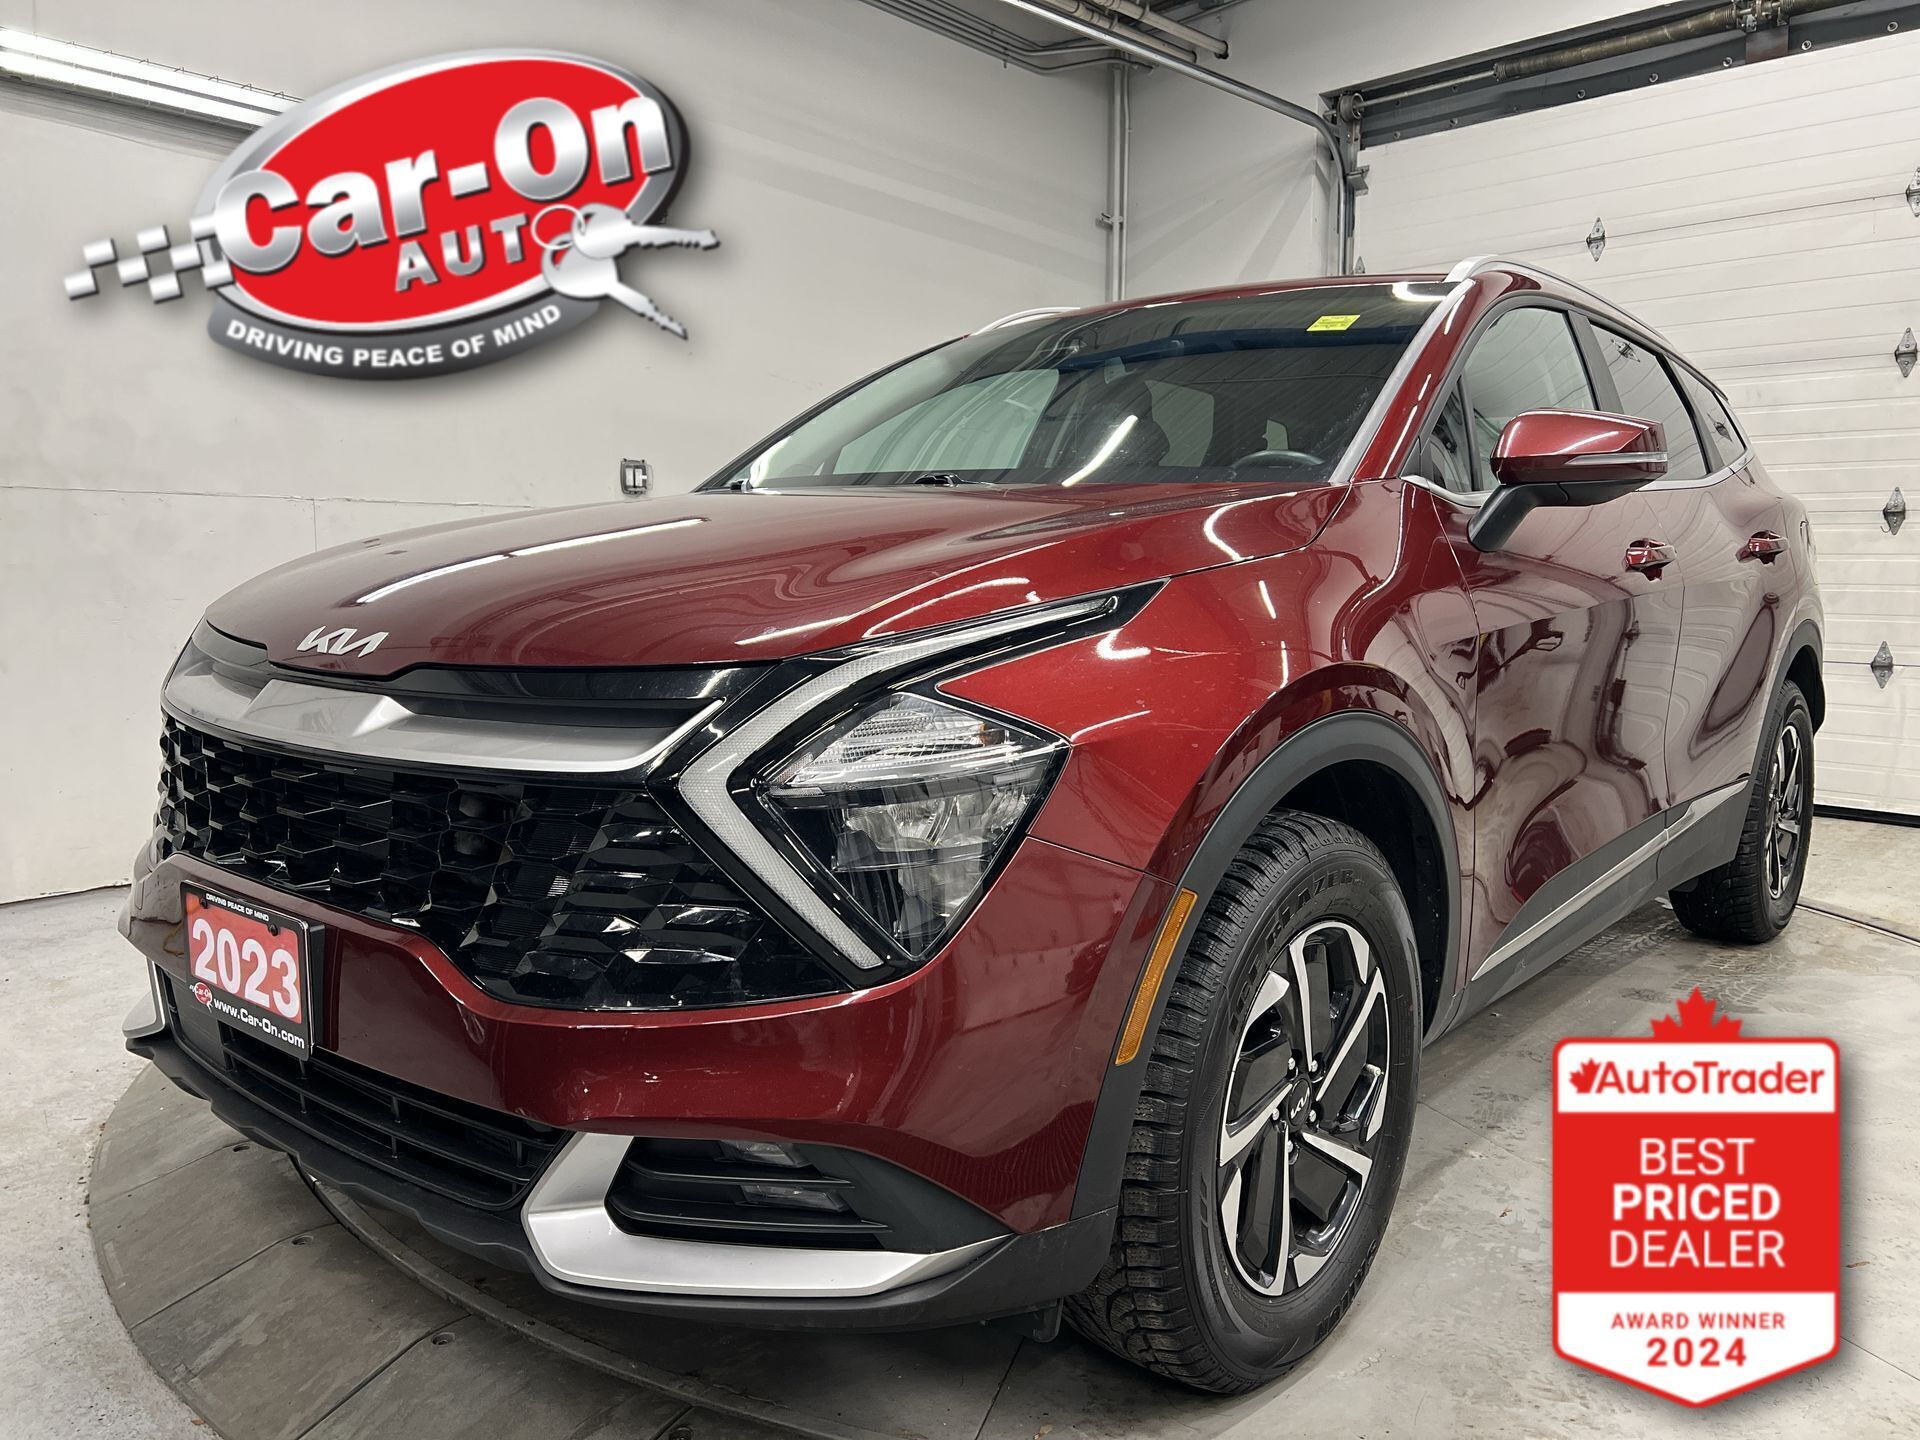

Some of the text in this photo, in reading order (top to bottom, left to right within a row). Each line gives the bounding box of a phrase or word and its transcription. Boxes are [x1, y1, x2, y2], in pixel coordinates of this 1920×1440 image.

[296, 625, 390, 658] KIA
[205, 892, 270, 922] DRIVING PEACE OF MIND
[192, 918, 300, 1018] 2023
[213, 998, 305, 1050] www.Car-On.com
